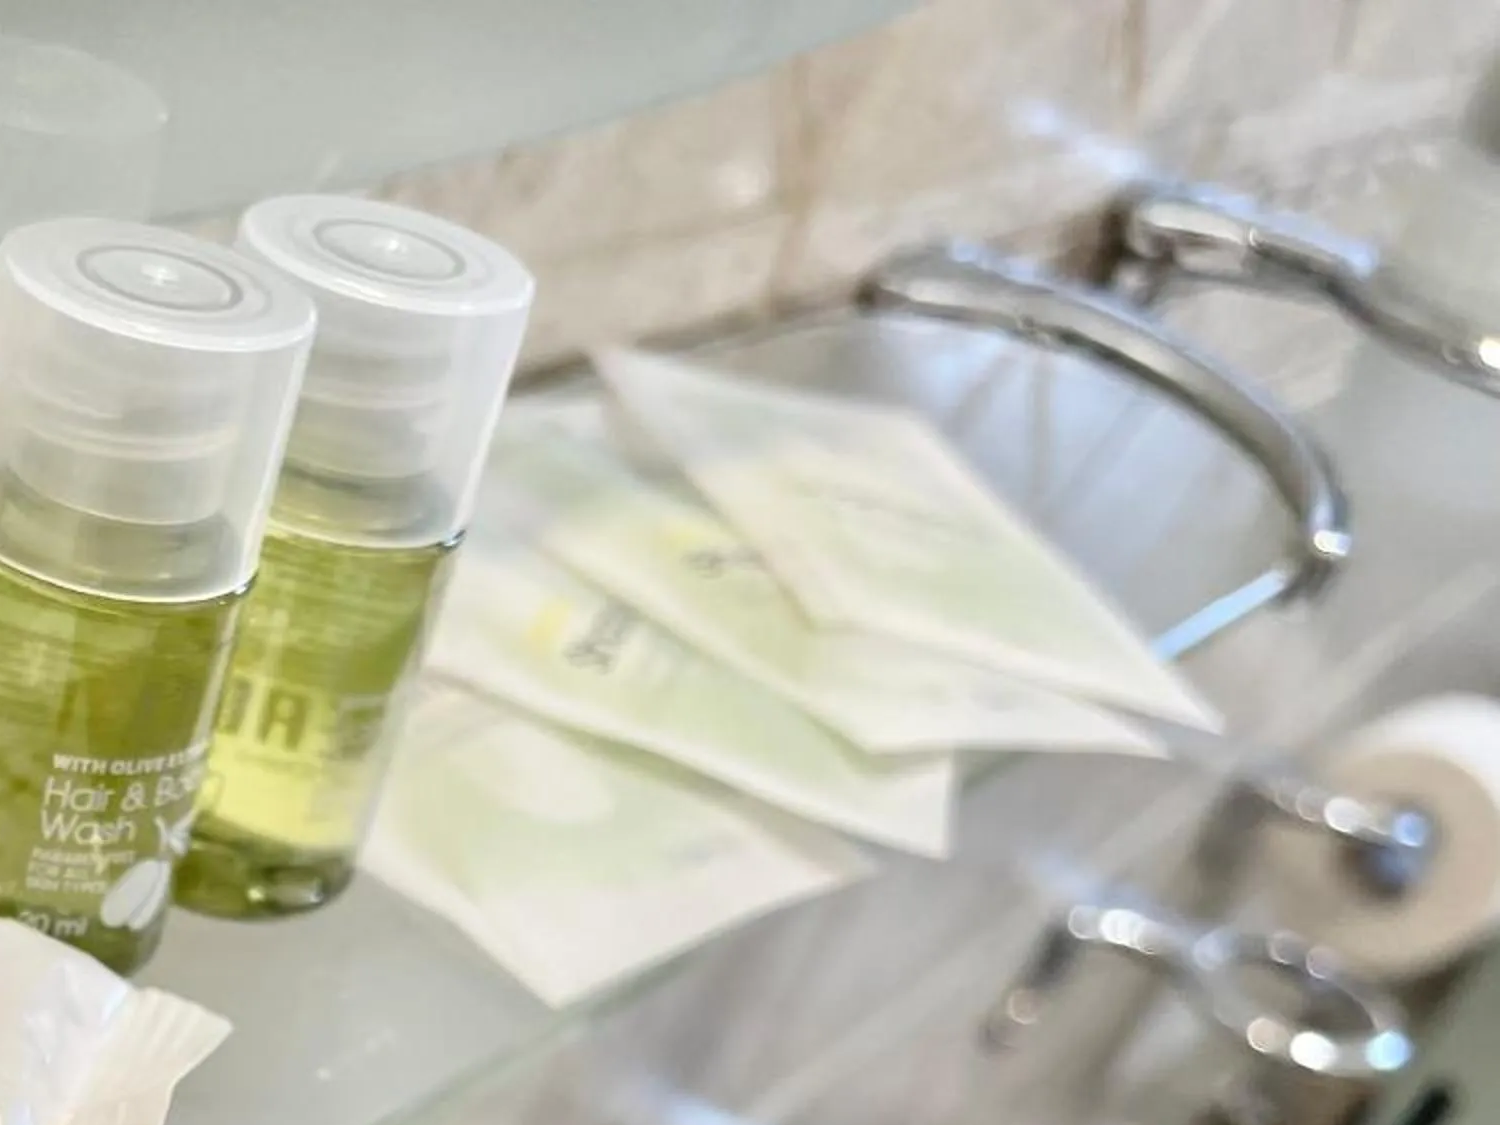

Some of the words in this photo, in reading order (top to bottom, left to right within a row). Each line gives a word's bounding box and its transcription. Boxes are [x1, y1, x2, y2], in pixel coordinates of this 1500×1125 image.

[53, 753, 106, 775] WITH
[42, 774, 115, 813] Hair
[119, 781, 148, 813] &
[40, 808, 137, 845] Wash
